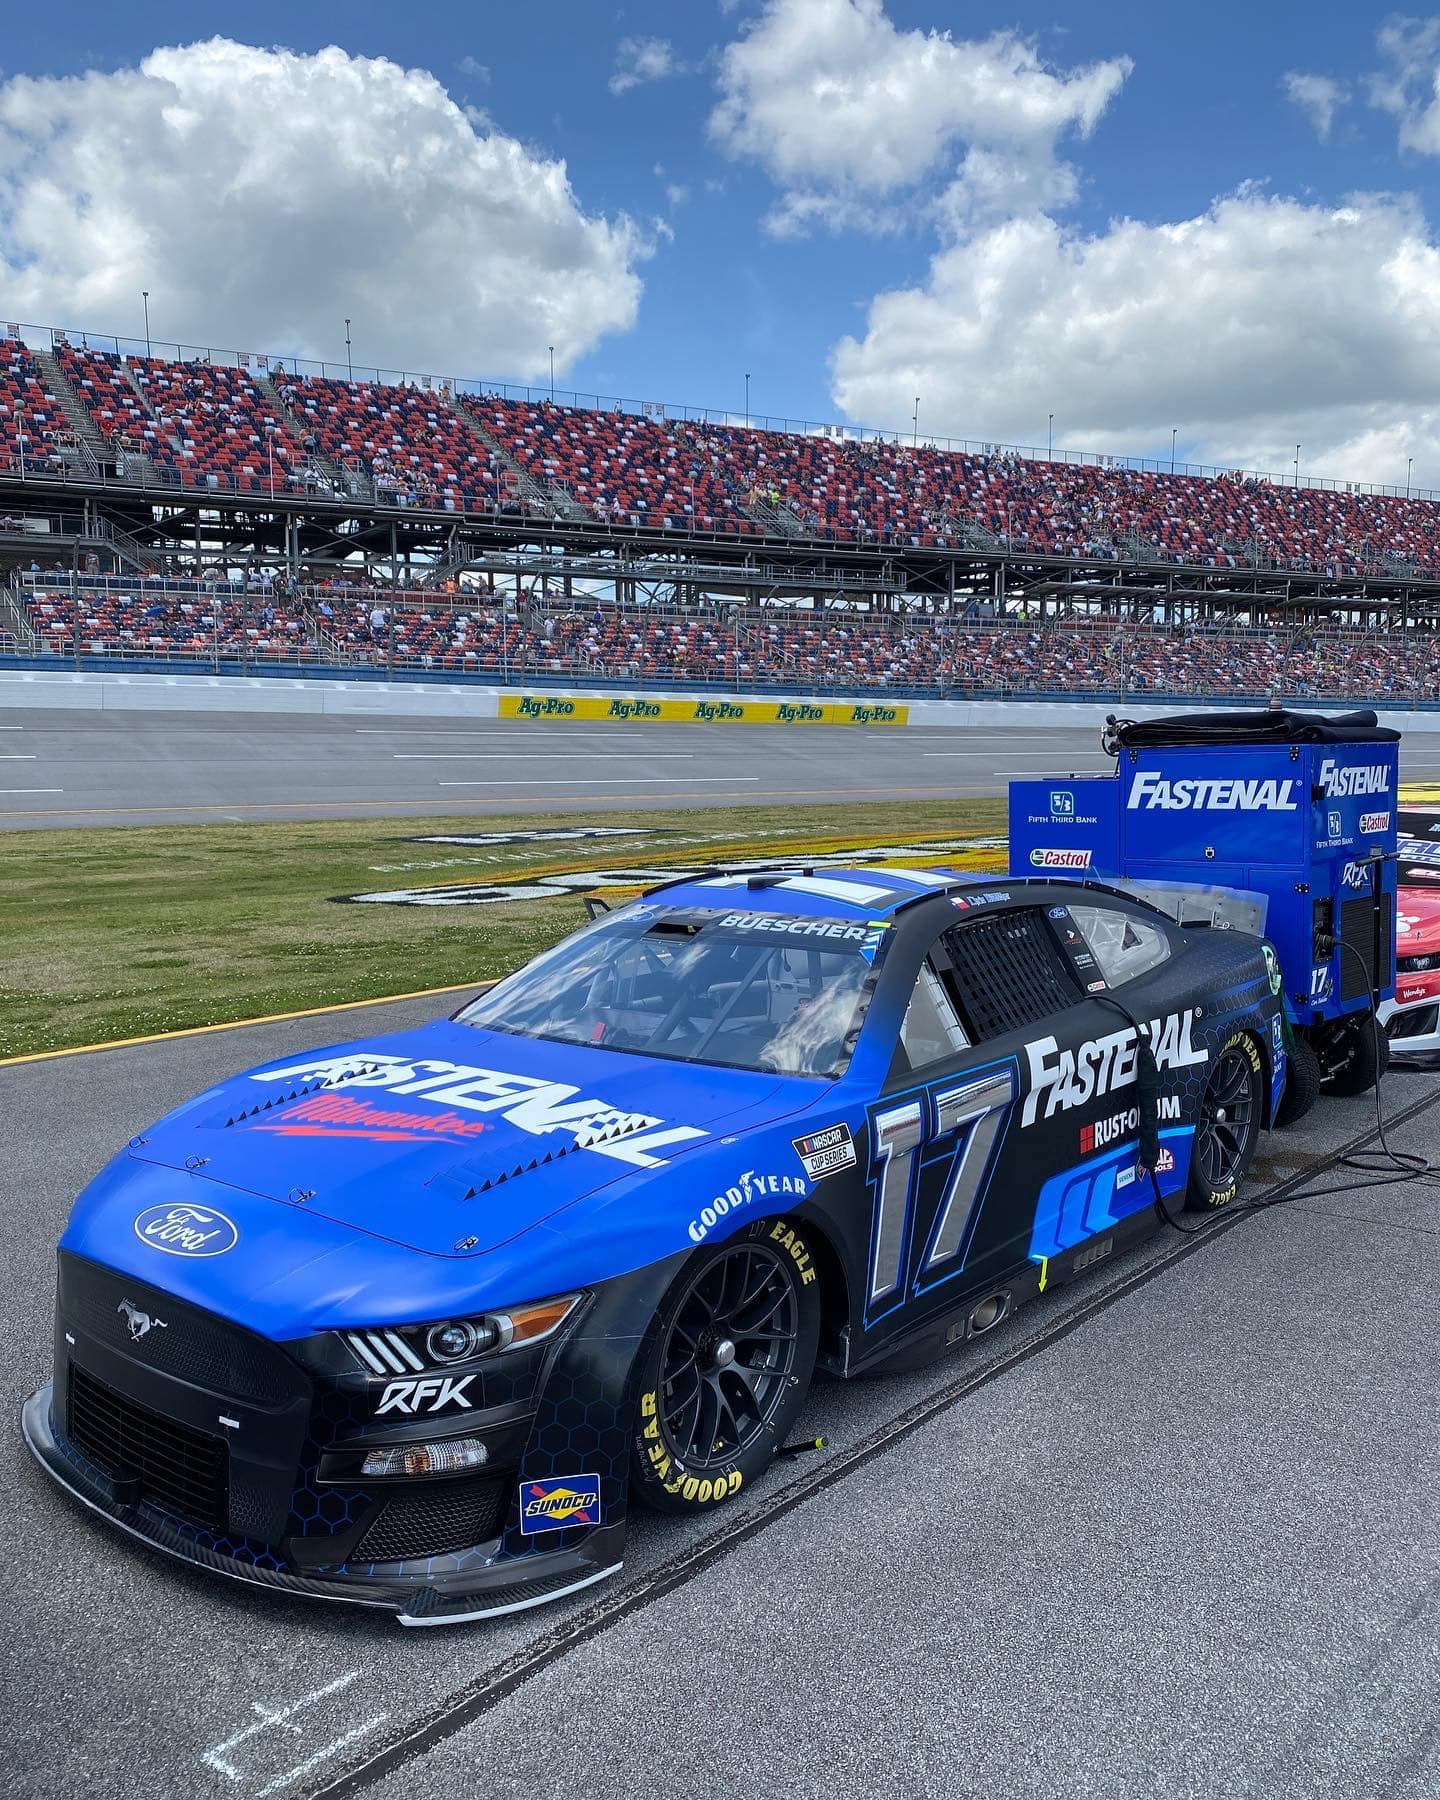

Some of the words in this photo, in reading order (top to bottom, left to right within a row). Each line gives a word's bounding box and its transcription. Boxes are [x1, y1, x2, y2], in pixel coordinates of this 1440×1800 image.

[517, 697, 575, 717] Ag-Pro
[609, 699, 661, 719] Ag-Pro
[695, 701, 743, 722] Ag-Pro
[775, 704, 823, 723] Ag-Pro
[851, 706, 896, 725] Ag-Pro
[1319, 759, 1390, 798] FASTENAL
[1127, 772, 1298, 810] FASTENAL
[1367, 814, 1390, 832] Castrol
[1329, 839, 1341, 847] THIRD
[1342, 838, 1354, 846] BANK
[1044, 851, 1089, 867] Castrol
[718, 914, 867, 941] BUESCHER
[1311, 967, 1328, 995] 17
[248, 1053, 711, 1169] FASTENAL
[265, 1093, 487, 1138] Milwaukee
[1094, 1096, 1181, 1148] RUST-OM
[812, 1129, 842, 1149] NASCAR
[810, 1155, 825, 1170] CUP
[825, 1147, 848, 1166] SERIES
[867, 1066, 1015, 1308] 17
[1209, 1184, 1236, 1206] EAGLE
[144, 1207, 221, 1250] Ford
[769, 1220, 816, 1285] EAGLE
[374, 1375, 477, 1415] RFK
[526, 1493, 596, 1516] SUNOCO
